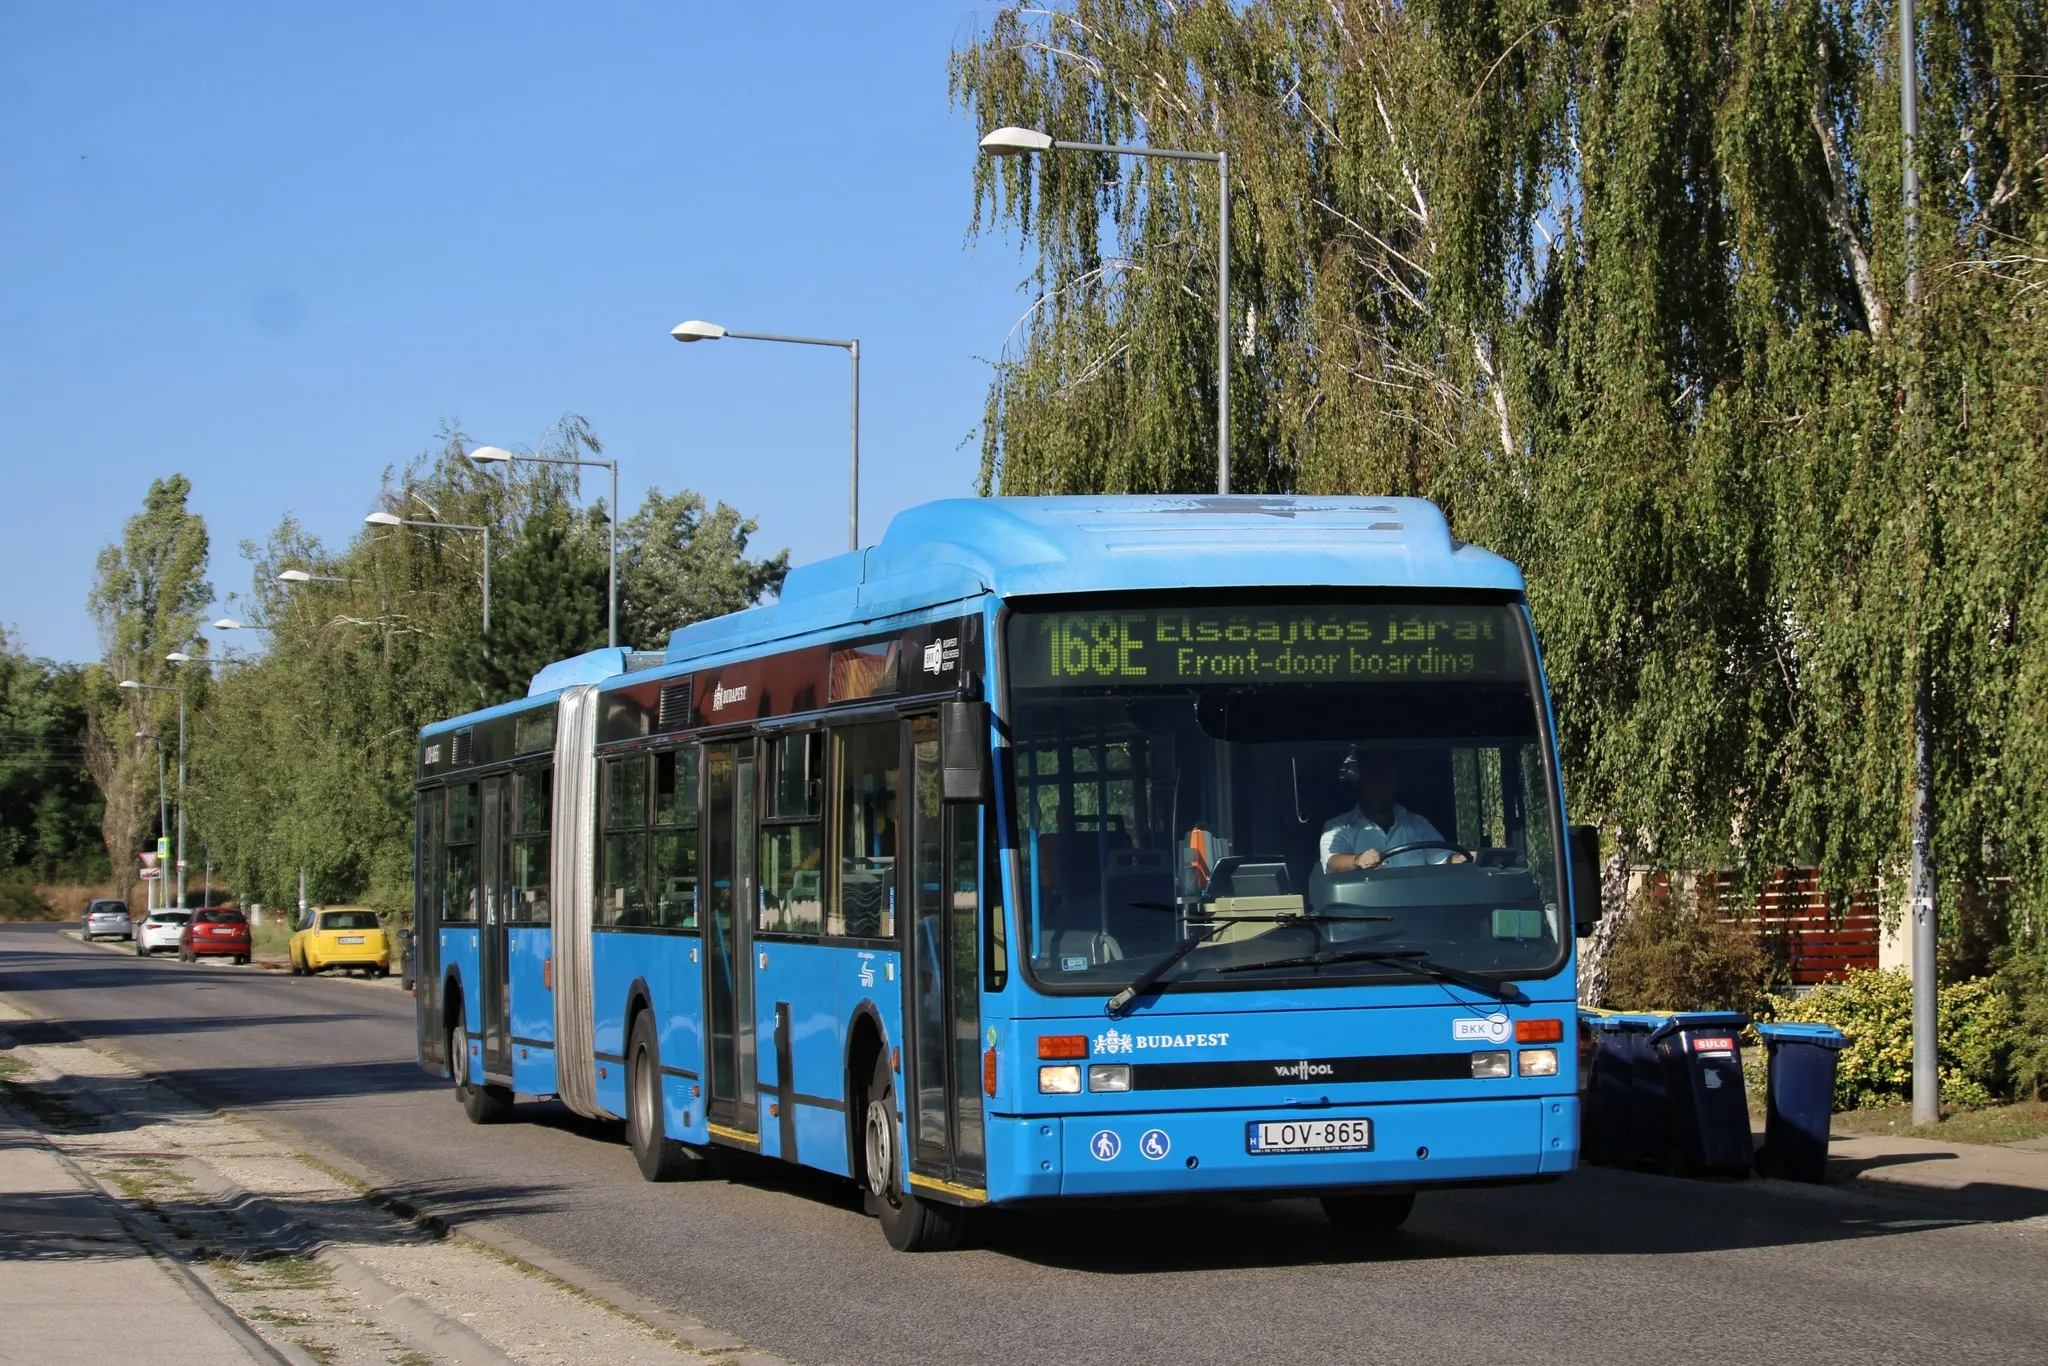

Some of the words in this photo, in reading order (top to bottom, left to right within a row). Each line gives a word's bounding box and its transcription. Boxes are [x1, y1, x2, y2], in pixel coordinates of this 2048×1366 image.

[1040, 615, 1147, 676] 168E
[1178, 648, 1341, 675] Front-door
[1350, 647, 1474, 674] boarding
[1461, 1024, 1486, 1034] BKK
[1136, 1033, 1230, 1049] BUDAPEST
[1698, 1040, 1728, 1048] SULO
[1264, 1122, 1364, 1146] LOV-865
